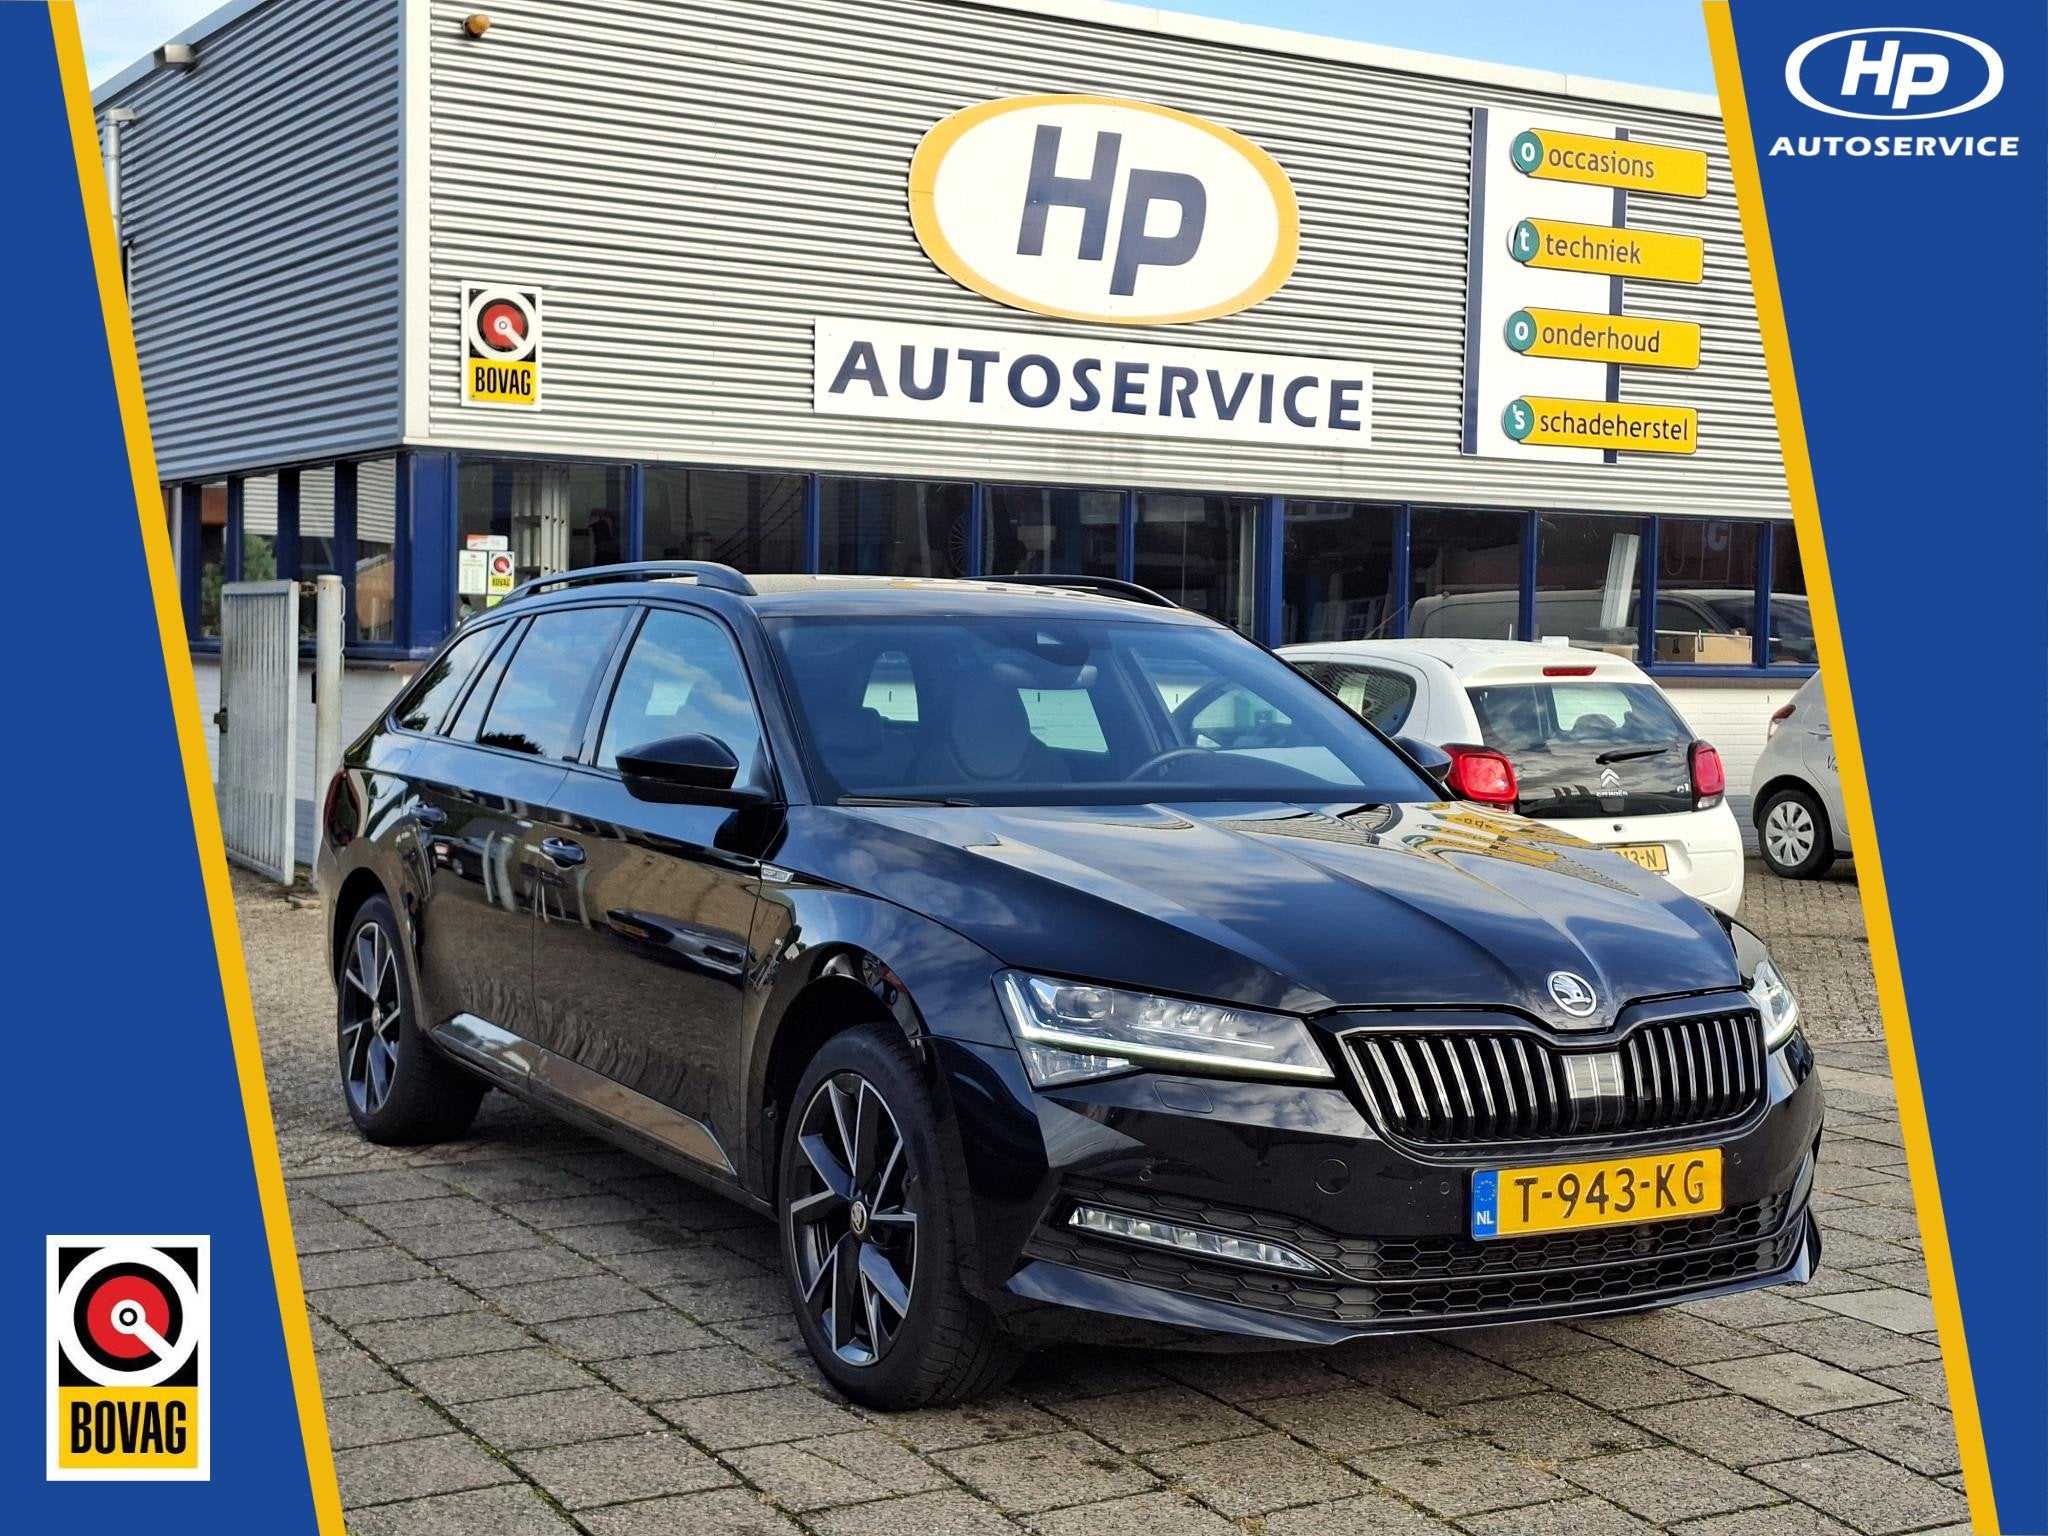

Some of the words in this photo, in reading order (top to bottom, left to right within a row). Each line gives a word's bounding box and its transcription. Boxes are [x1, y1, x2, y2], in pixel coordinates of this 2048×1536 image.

[1549, 148, 1655, 179] occasions
[1016, 124, 1207, 297] Hp
[1519, 227, 1530, 251] t
[1546, 233, 1641, 264] techniek
[1542, 323, 1660, 353] onderhoud
[475, 366, 531, 396] BOVAG
[828, 340, 1364, 432] AUTOSERVICE
[1540, 410, 1688, 441] schadeherstel
[1514, 1160, 1704, 1223] T-943-KG
[1476, 1211, 1494, 1225] NL
